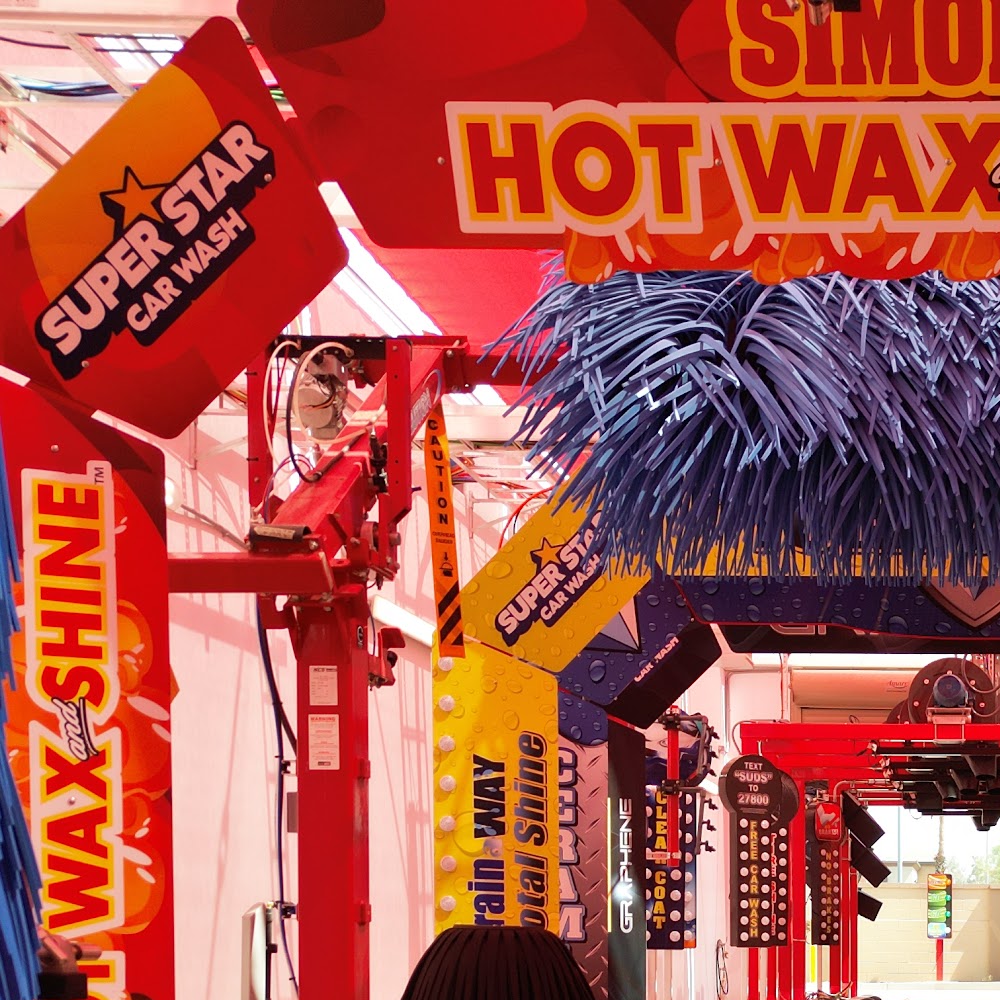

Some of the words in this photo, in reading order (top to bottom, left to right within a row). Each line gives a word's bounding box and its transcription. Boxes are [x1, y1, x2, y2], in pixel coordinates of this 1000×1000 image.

[457, 111, 704, 223] HOT
[41, 220, 175, 356] SUPER
[160, 124, 269, 237] STAR
[126, 276, 182, 332] CAR
[170, 207, 248, 285] WASH
[427, 419, 449, 525] CAUTION
[34, 479, 110, 712] SHINE
[497, 563, 566, 635] SUPER
[540, 591, 570, 621] CAR
[563, 553, 601, 595] WASH
[51, 696, 99, 763] and
[514, 731, 548, 847] Shine
[737, 793, 769, 805] 27800
[744, 761, 763, 771] TEXT
[748, 784, 759, 792] TO
[40, 737, 114, 932] WAX
[619, 797, 632, 935] GRAPHENE
[749, 821, 758, 860] FREE
[825, 851, 832, 871] NO
[468, 859, 506, 927] rain
[515, 850, 549, 928] otal
[652, 870, 667, 930] COAT
[749, 864, 758, 894] CAR
[749, 897, 760, 938] WASH
